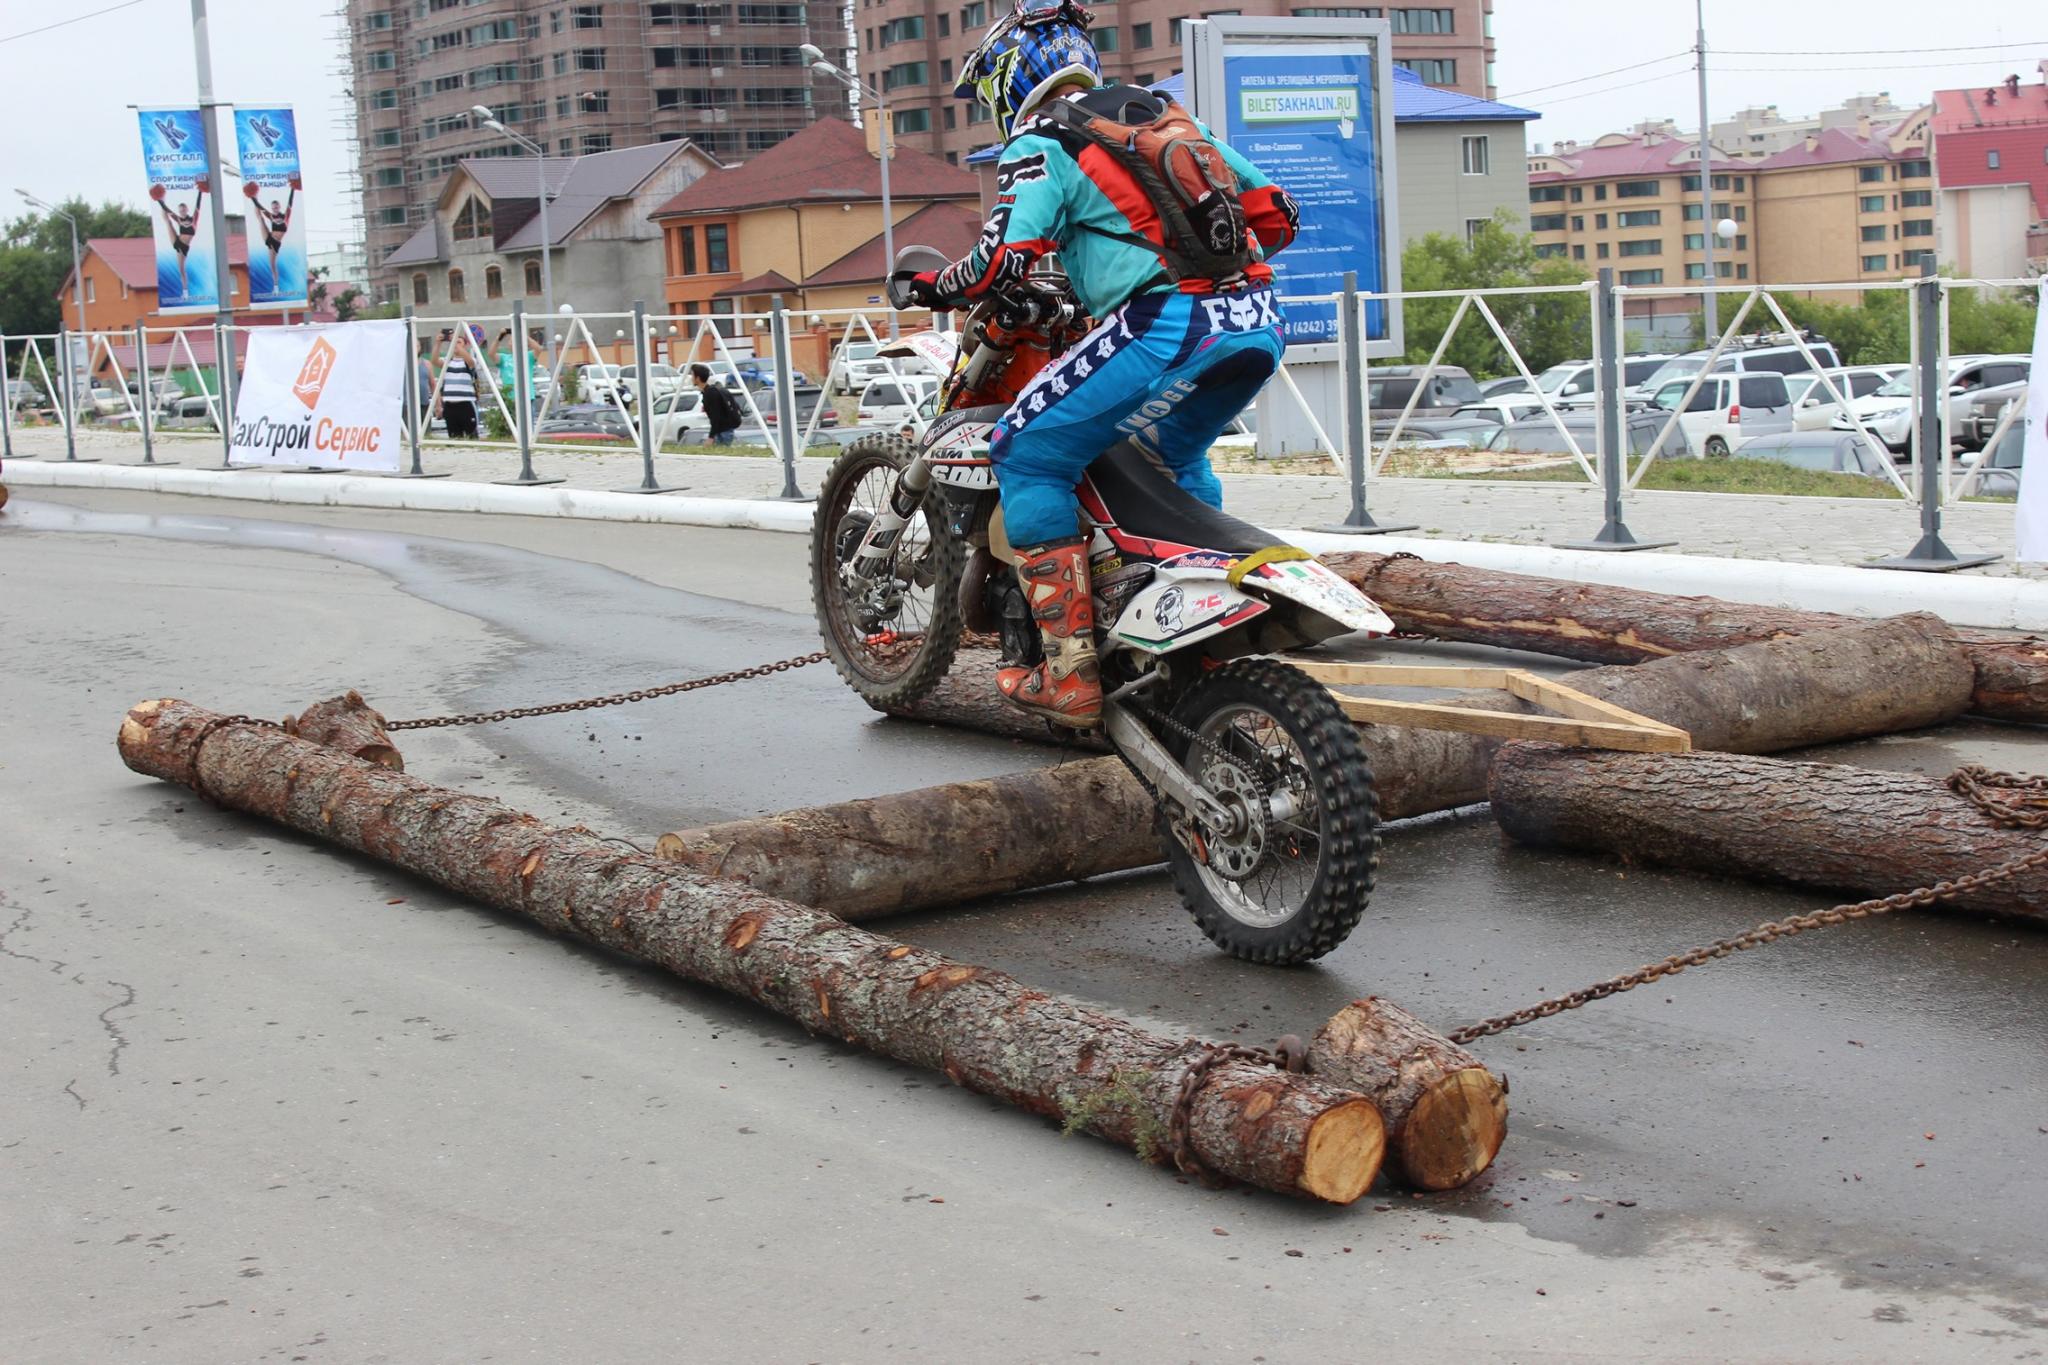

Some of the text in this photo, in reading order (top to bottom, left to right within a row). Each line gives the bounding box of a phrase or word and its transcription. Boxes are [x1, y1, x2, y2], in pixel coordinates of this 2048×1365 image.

[1247, 96, 1352, 112] BILETSAKHALIN.RU
[149, 152, 203, 162] КРИСТАЛЛ
[243, 151, 296, 160] КРИСТАЛЛ
[1293, 319, 1325, 336] (4242)
[315, 416, 381, 460] Сервис
[930, 447, 963, 459] KTM
